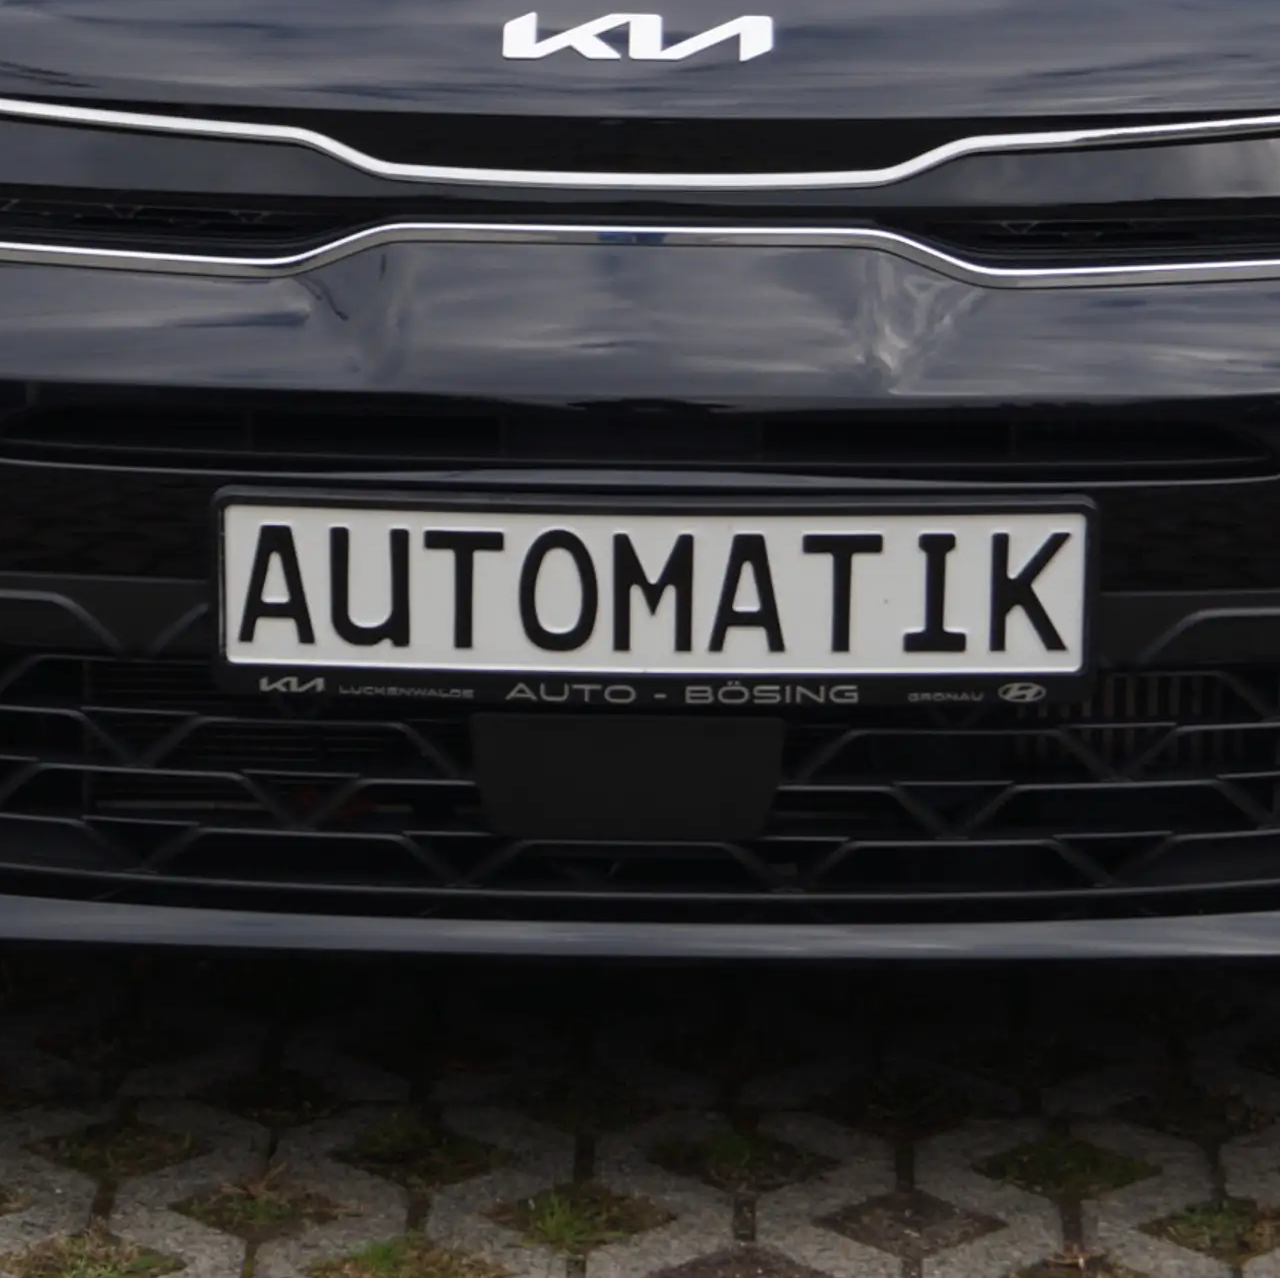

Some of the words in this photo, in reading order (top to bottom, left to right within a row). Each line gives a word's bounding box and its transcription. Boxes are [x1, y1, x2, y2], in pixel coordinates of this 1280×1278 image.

[502, 11, 774, 62] KIA
[237, 524, 1072, 654] AUTOMATIK
[259, 676, 325, 693] KIA
[505, 682, 637, 704] AUTO
[684, 680, 859, 705] BÖSING
